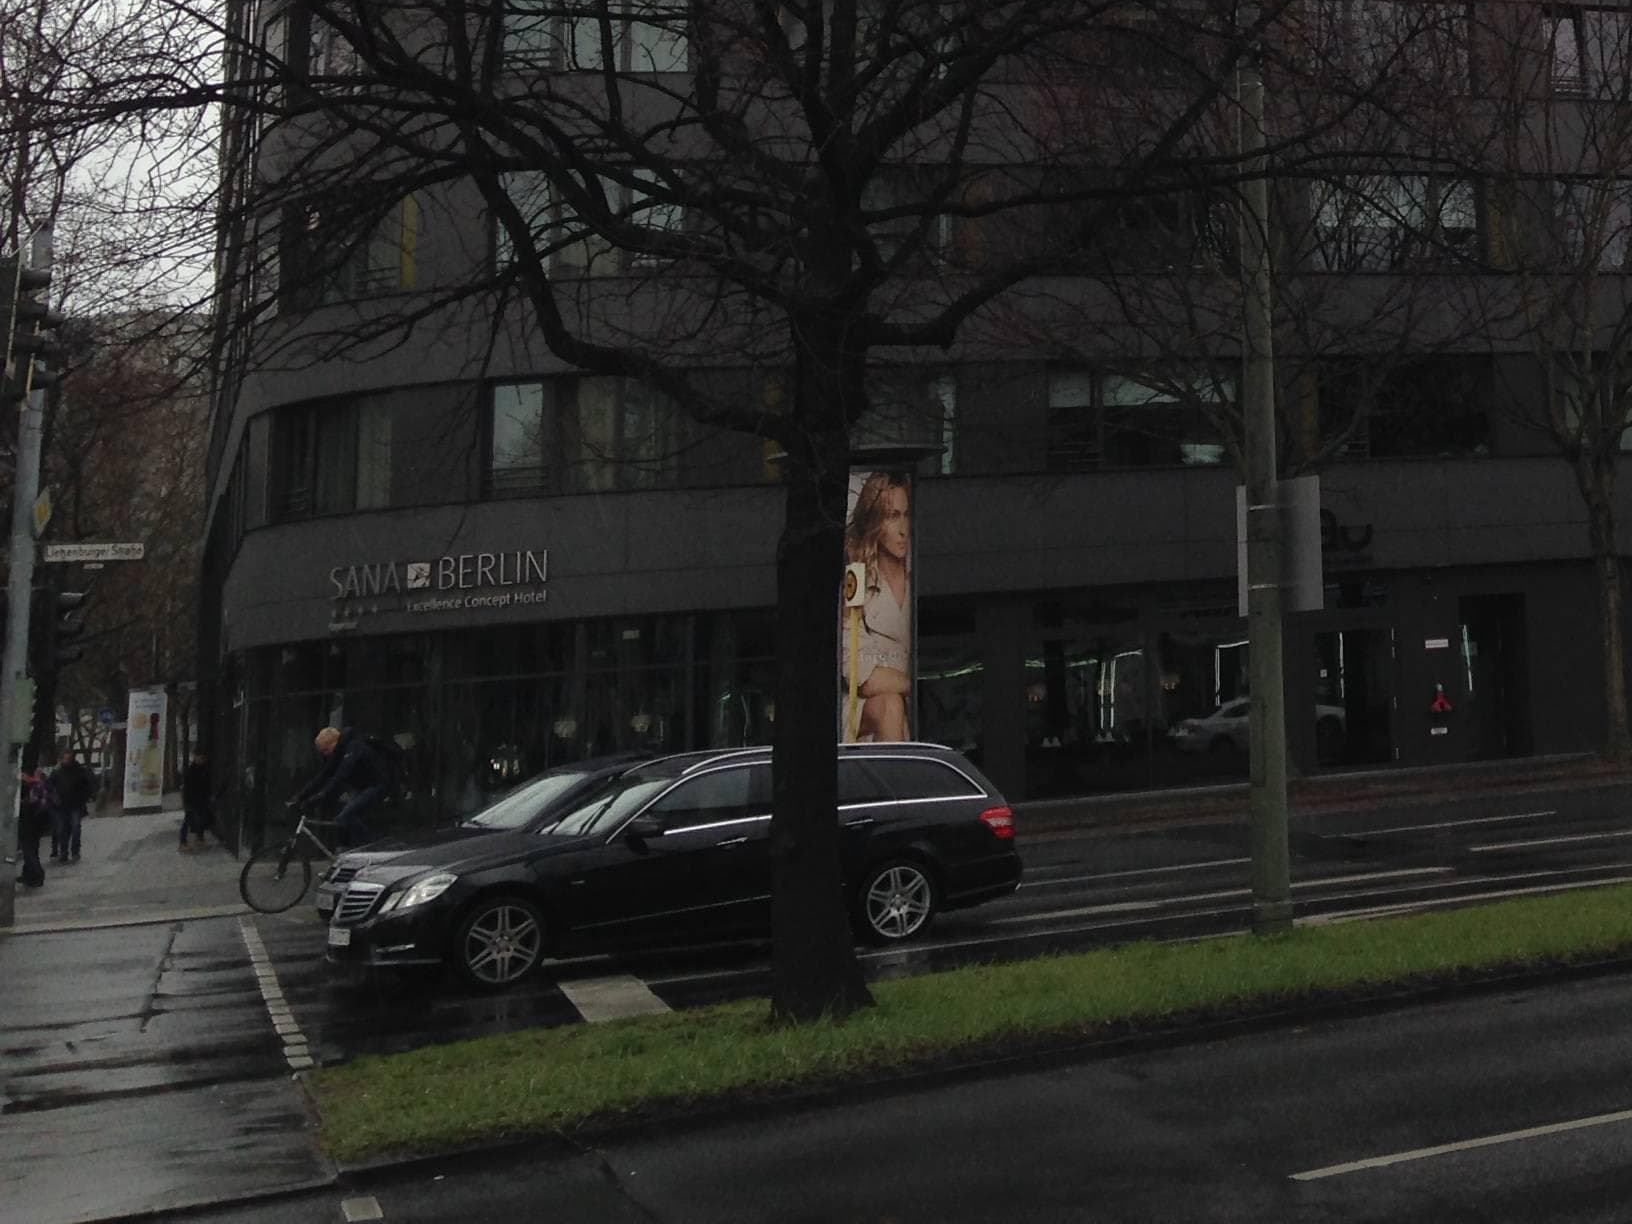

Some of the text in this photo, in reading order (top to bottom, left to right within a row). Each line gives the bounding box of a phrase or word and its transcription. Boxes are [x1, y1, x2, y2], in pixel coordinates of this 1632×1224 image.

[329, 549, 548, 600] SANA BERLIN
[464, 594, 512, 608] Concept
[514, 590, 547, 603] Hotel
